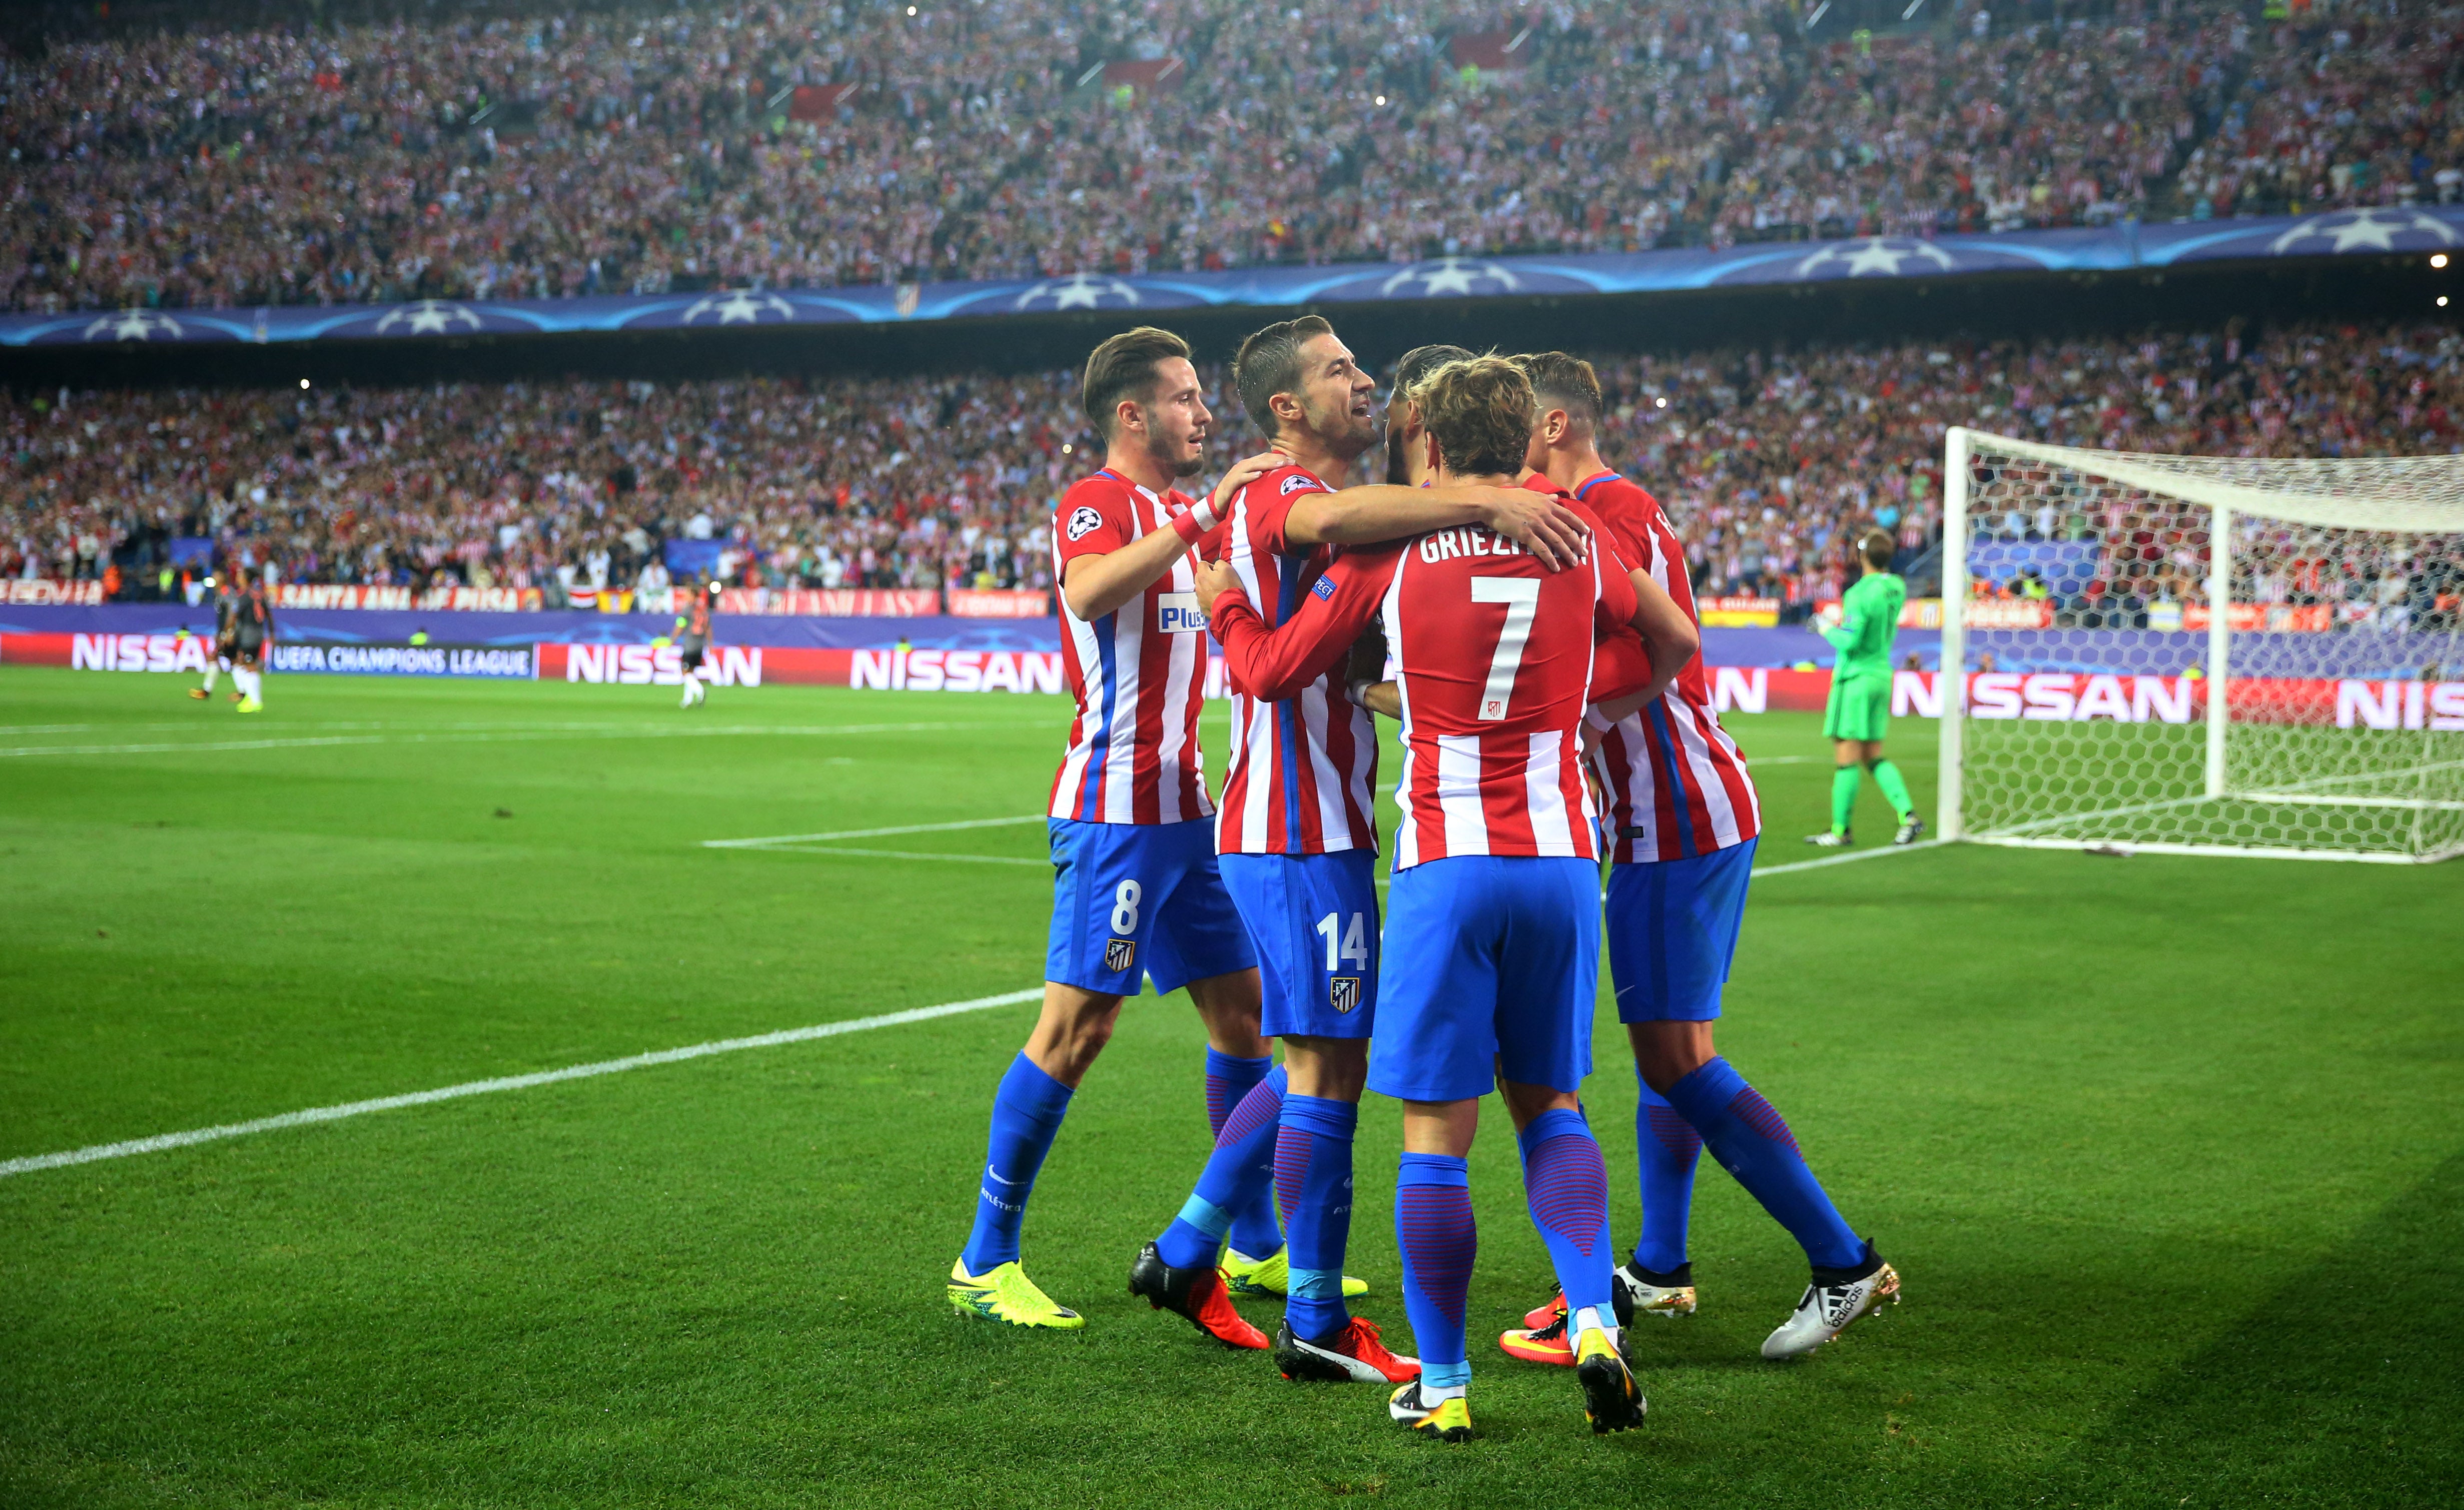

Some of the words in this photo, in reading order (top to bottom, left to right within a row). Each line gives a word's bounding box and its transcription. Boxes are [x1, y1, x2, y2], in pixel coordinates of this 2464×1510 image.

[1420, 527, 1587, 565] GRIEZ
[273, 646, 326, 671] UEFA
[328, 646, 446, 673] CHAMPIONS
[451, 649, 529, 676] LEAGUE
[566, 643, 762, 687] NISSAN
[1470, 576, 1541, 720] 7
[850, 649, 1064, 694] NISSAN
[1111, 879, 1142, 935] 8
[1316, 912, 1367, 971] 14
[1827, 1286, 1863, 1327] adidas
